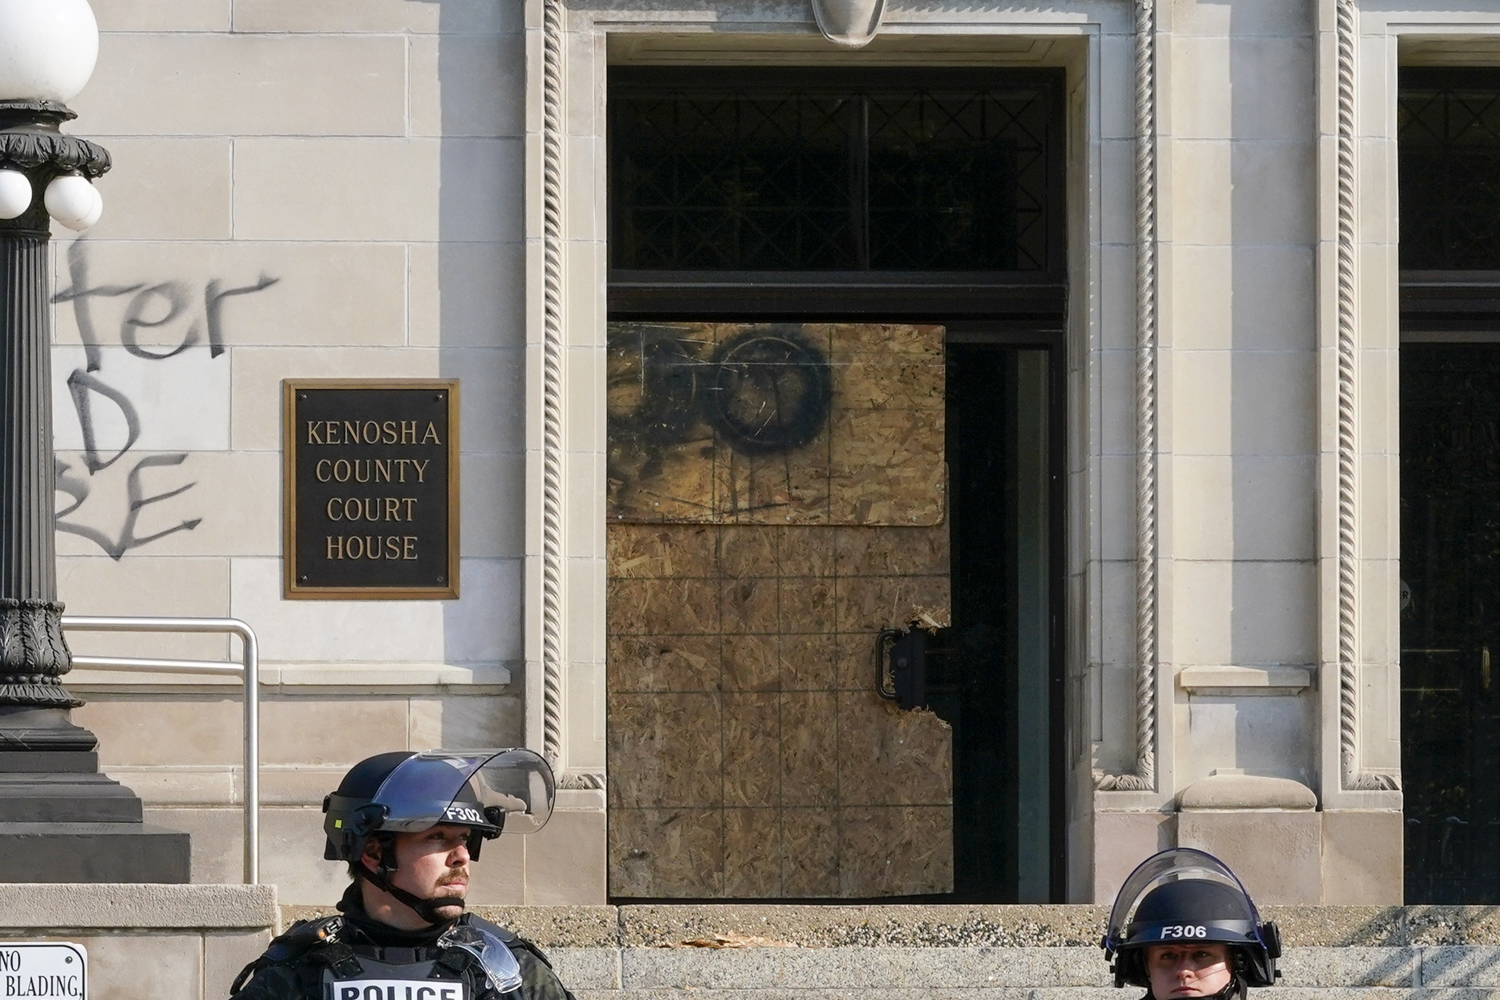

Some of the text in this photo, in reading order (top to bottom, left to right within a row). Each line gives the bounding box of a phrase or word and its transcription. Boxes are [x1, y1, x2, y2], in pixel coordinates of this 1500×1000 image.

[307, 420, 441, 445] KENOSHA
[315, 459, 430, 483] COUNTY
[326, 497, 418, 522] COURT
[326, 536, 418, 560] HOUSE
[444, 807, 484, 824] F302
[1160, 925, 1207, 940] F306
[0, 950, 21, 972] NO
